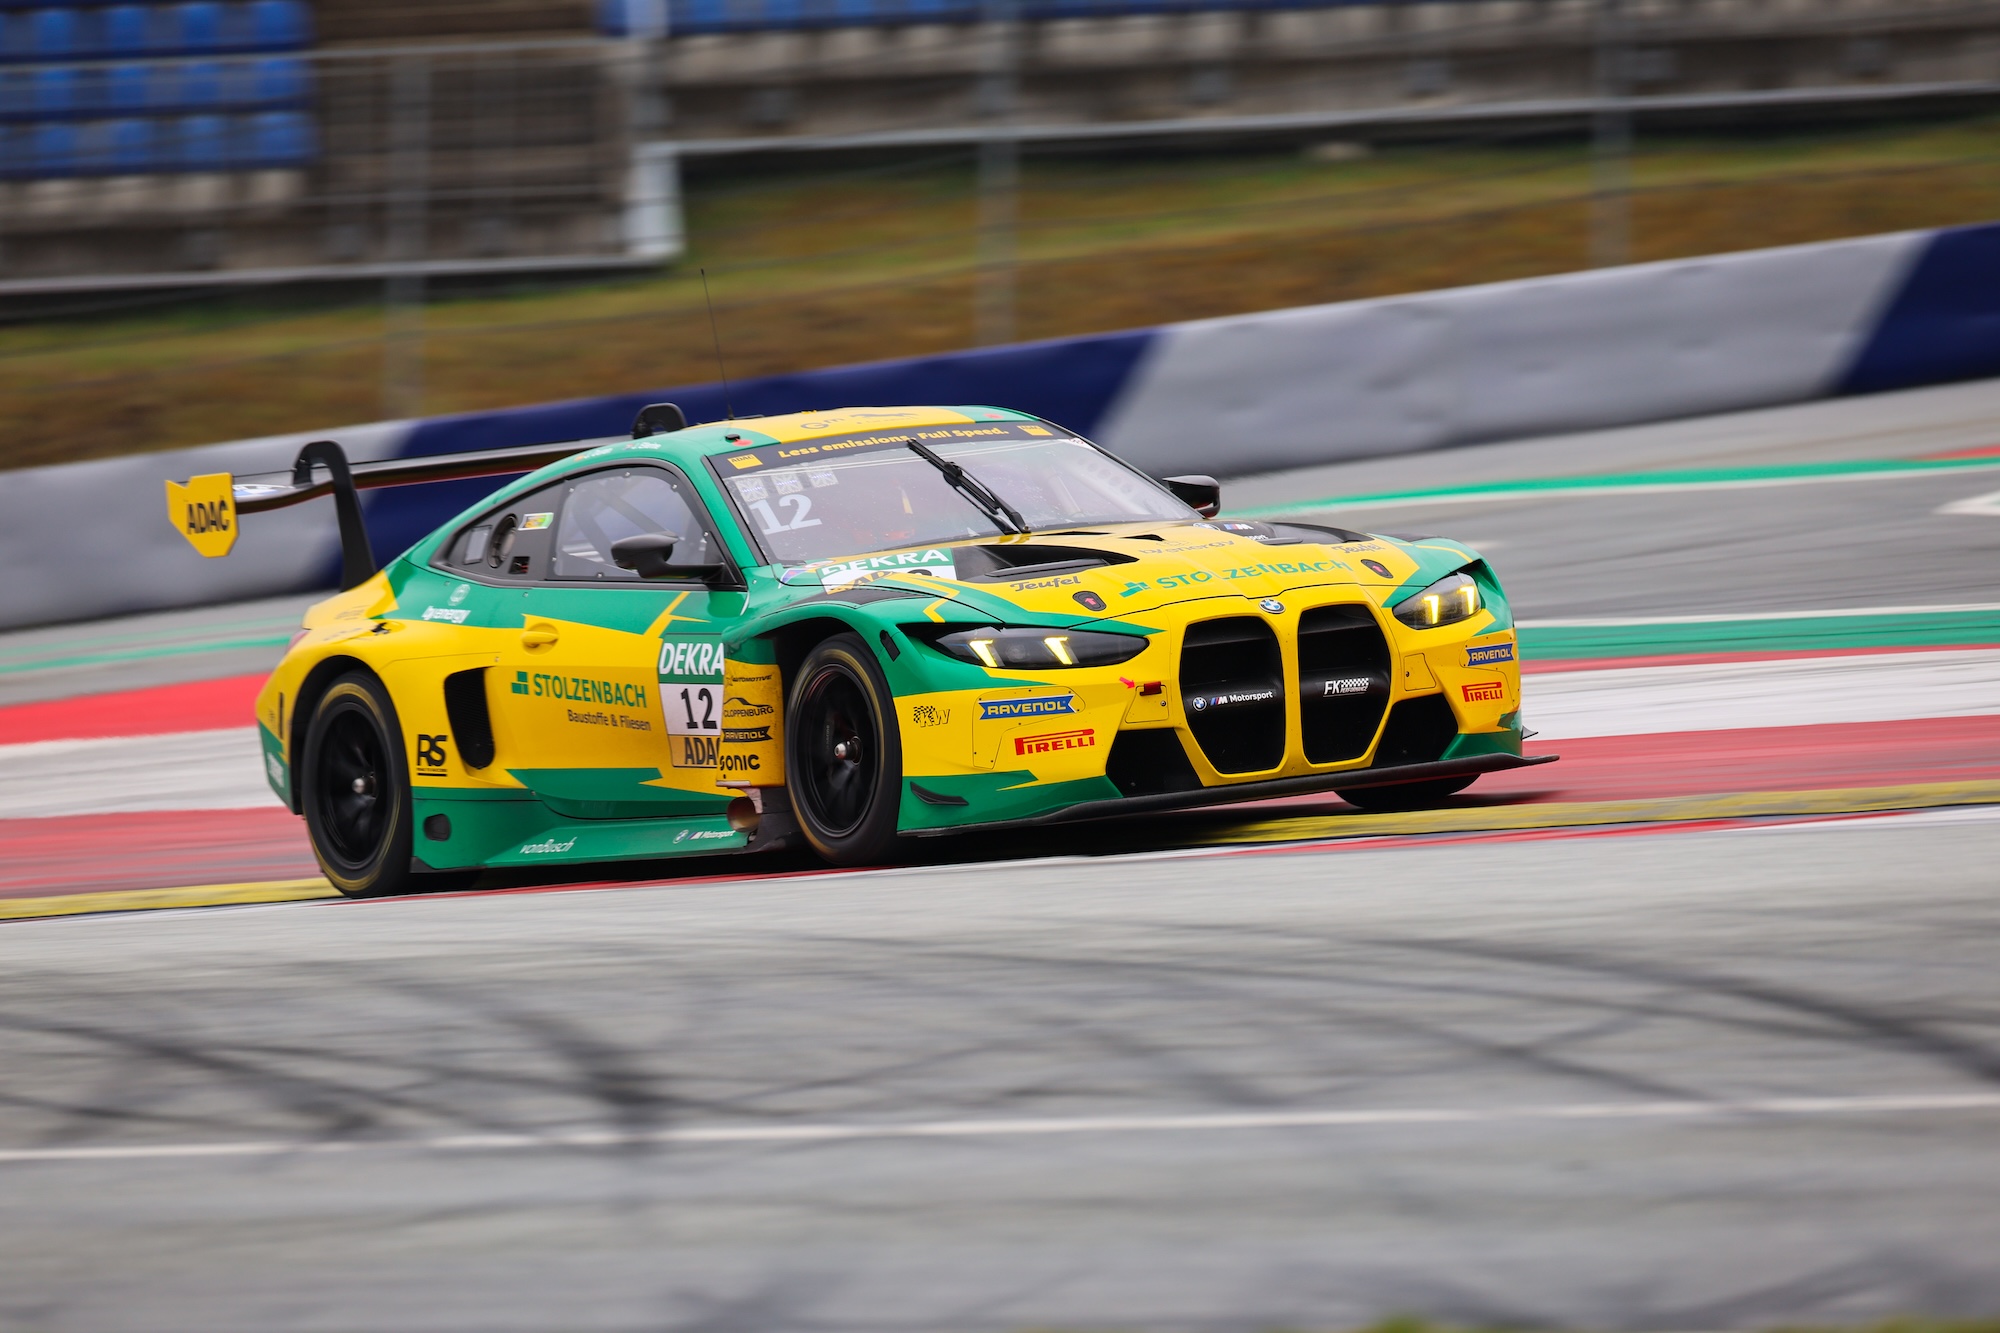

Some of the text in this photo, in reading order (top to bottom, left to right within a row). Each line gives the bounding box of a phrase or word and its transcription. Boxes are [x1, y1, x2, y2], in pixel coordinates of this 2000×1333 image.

[777, 446, 820, 459] Less
[917, 429, 951, 440] Full
[952, 427, 1010, 438] Speed.
[186, 499, 230, 535] ADAC
[749, 494, 823, 535] 12
[821, 549, 949, 576] DEKRA
[1010, 575, 1082, 592] Teufel
[659, 642, 725, 675] DEKRA
[1471, 648, 1511, 662] RAVENOL
[533, 673, 648, 708] STOLZENBACH
[1229, 690, 1273, 703] Motorsport
[1323, 680, 1341, 695] FK
[1461, 681, 1503, 702] PIRELLI
[567, 708, 652, 732] Baustoffe & Fliesen
[680, 687, 718, 730] 12
[918, 707, 950, 727] KW
[987, 701, 1067, 716] RAVENOL
[725, 730, 765, 740] RAVENOL
[1014, 728, 1095, 756] PIRELLI
[417, 734, 447, 767] RS
[684, 736, 720, 766] ADA
